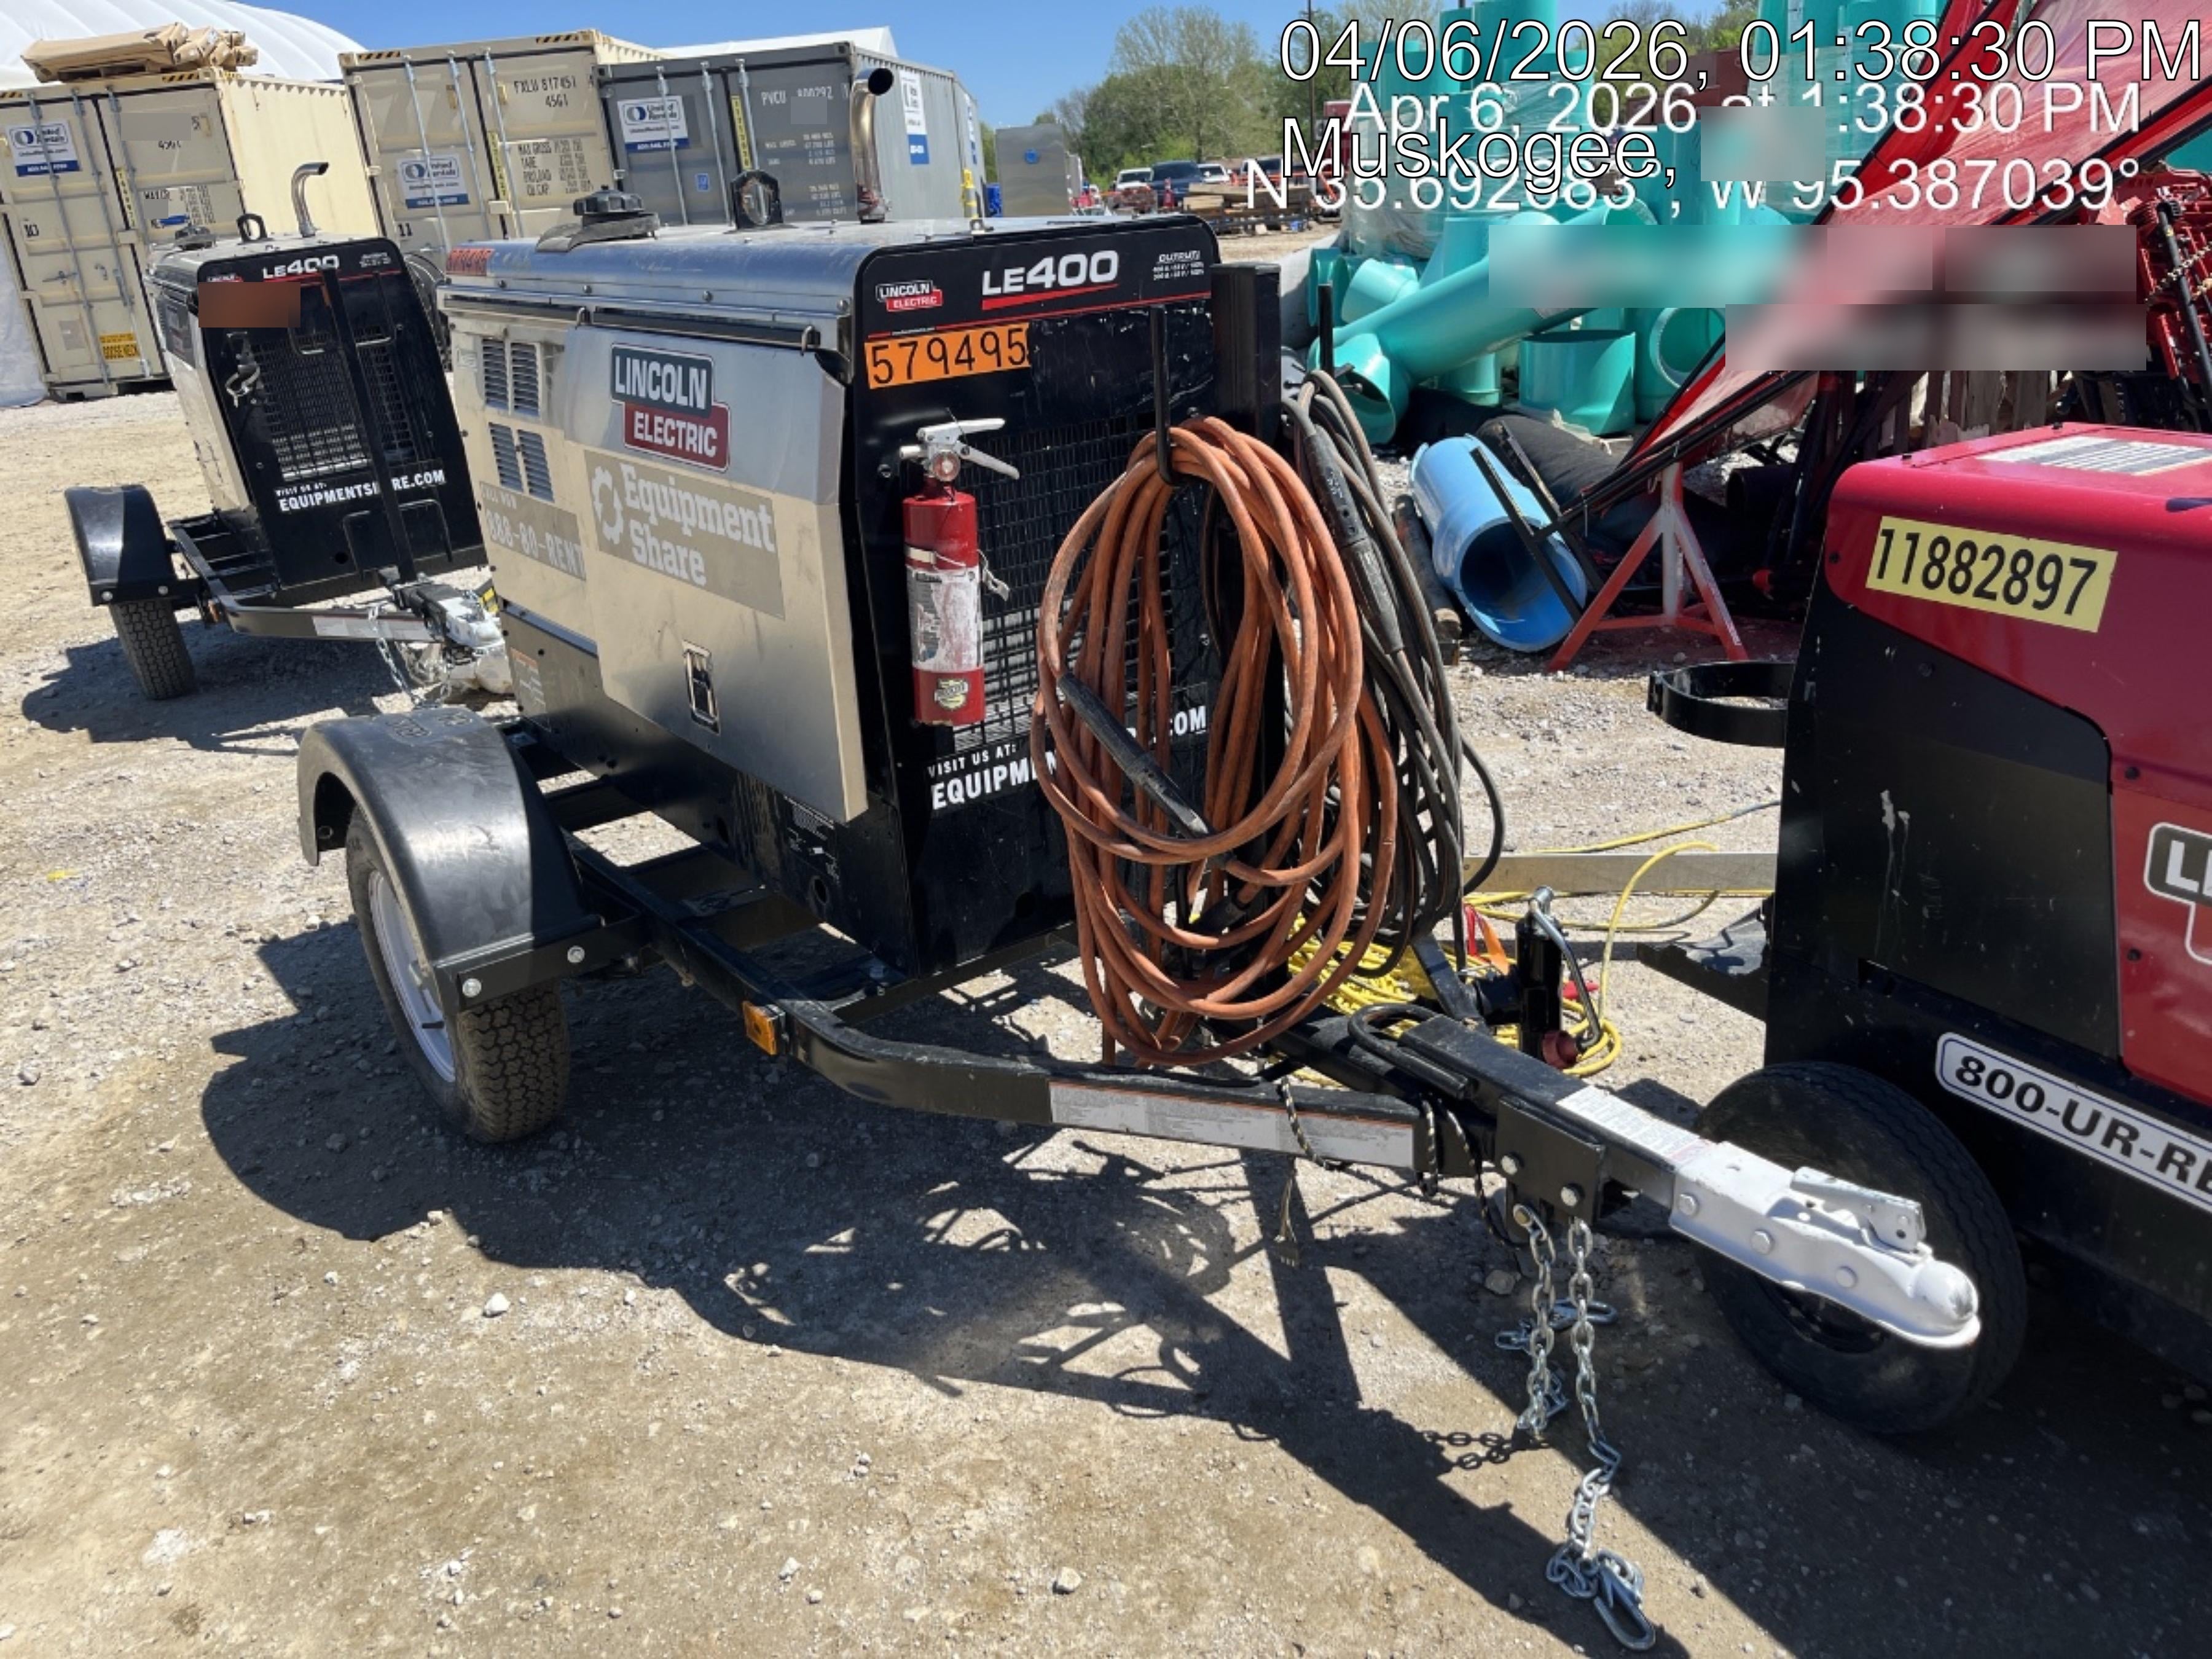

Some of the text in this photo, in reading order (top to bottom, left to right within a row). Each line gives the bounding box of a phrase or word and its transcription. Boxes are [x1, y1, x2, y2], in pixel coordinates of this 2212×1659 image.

[262, 254, 340, 279] LE400
[982, 250, 1119, 296] LE400
[879, 283, 930, 299] LINCOLN
[893, 296, 938, 308] ELECTRIC
[615, 355, 707, 410] LINCOLN
[633, 410, 718, 458] ELECTRIC
[278, 469, 446, 512] EQUIPMENTSRE.COM
[619, 462, 777, 553] Equipment
[629, 519, 707, 587] Share
[1876, 527, 2098, 616] 11882897
[927, 743, 1017, 779] VISIT US AT:
